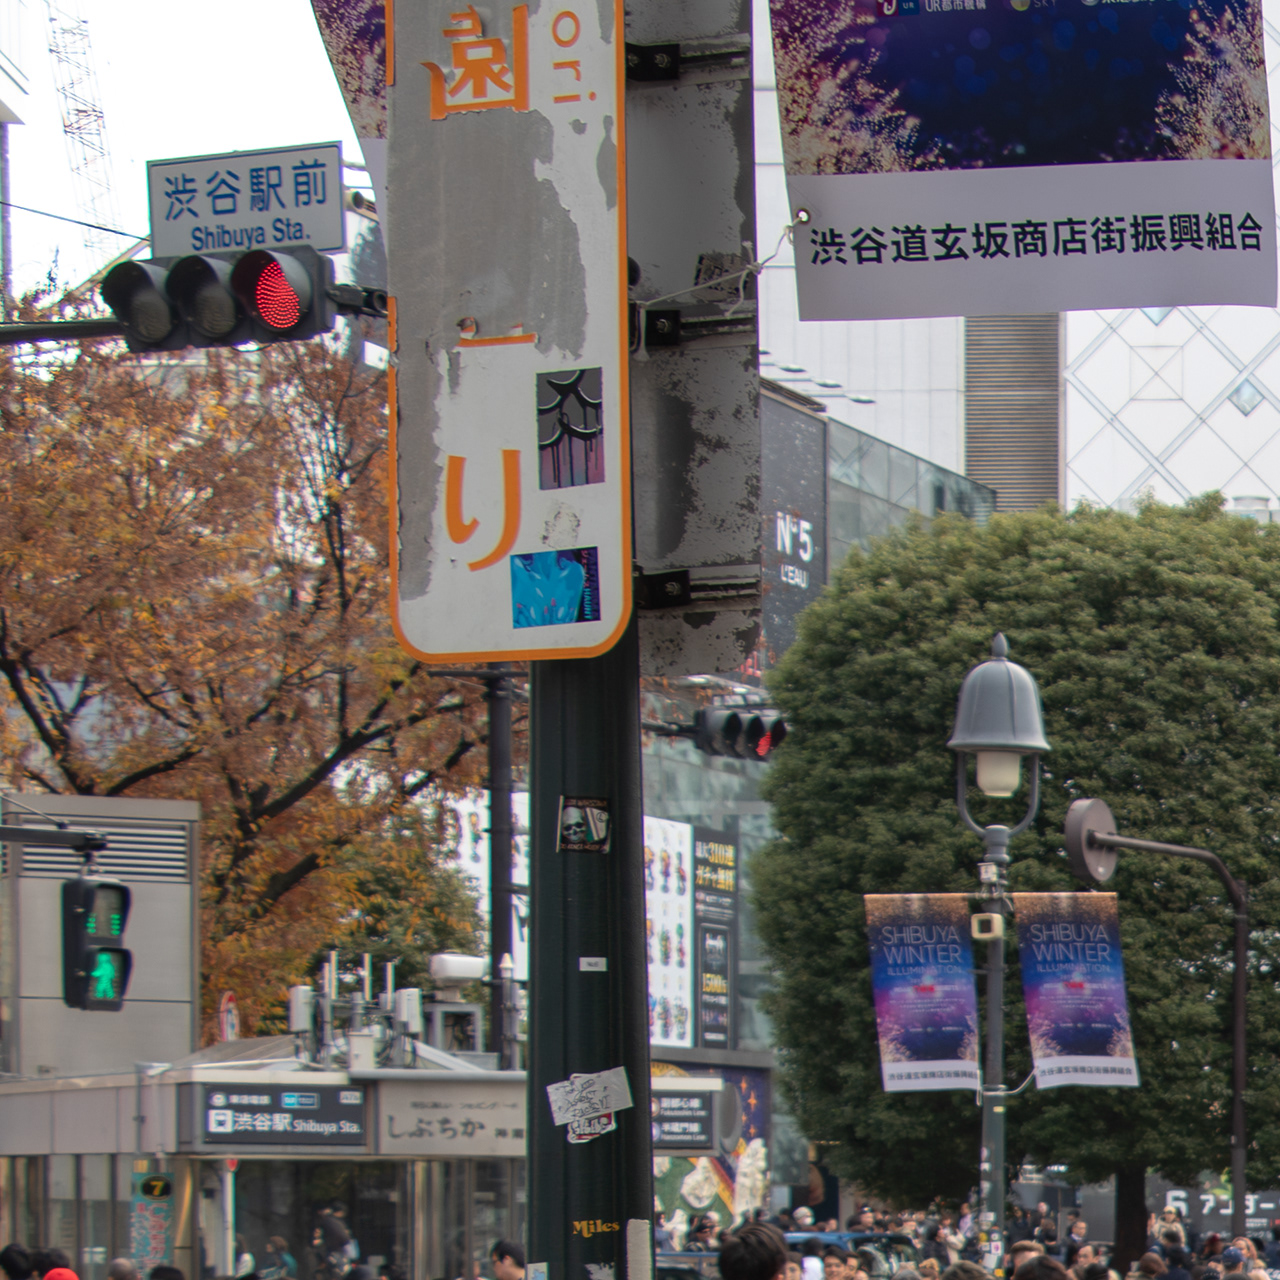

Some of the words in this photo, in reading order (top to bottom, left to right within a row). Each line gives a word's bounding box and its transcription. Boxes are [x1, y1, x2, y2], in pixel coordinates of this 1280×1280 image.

[164, 158, 327, 221] 渋谷駅前
[191, 224, 267, 251] Shibuya
[272, 217, 311, 242] Sta.
[809, 212, 1263, 267] 渋谷道玄坂商店街振興組合
[881, 925, 962, 946] SHIBUYA
[1030, 923, 1110, 943] SHIBUYA
[884, 944, 964, 965] WINTER
[1032, 942, 1111, 963] WINTER
[293, 1119, 338, 1136] Shibuya
[339, 1121, 361, 1133] Sta.
[572, 1219, 620, 1238] Miles
